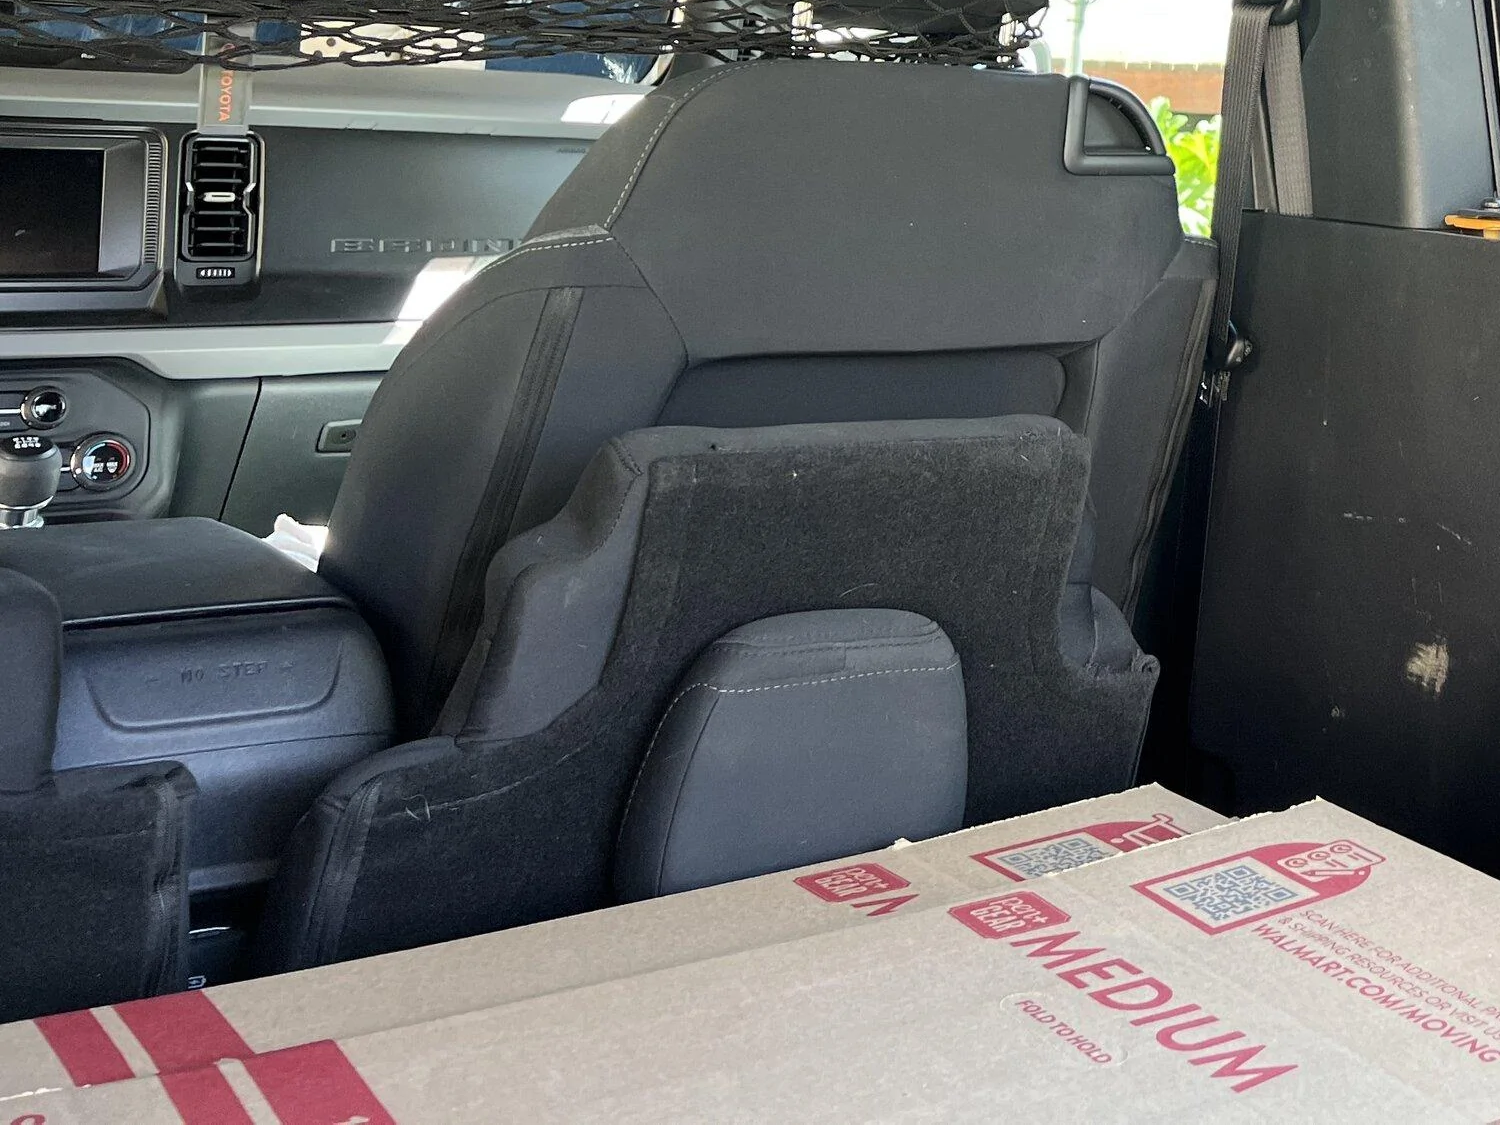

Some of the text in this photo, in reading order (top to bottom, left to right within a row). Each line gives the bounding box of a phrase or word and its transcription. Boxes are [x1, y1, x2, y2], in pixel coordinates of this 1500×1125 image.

[218, 661, 268, 679] STEP
[814, 874, 868, 897] GEAR
[970, 905, 1026, 932] GEAR
[1278, 917, 1293, 925] &
[1288, 922, 1351, 955] SHIPPING
[1345, 953, 1429, 998] RESOURCES
[1424, 996, 1452, 1011] OR
[1448, 1007, 1489, 1028] VISIT
[1300, 910, 1339, 931] SCAN
[1332, 925, 1375, 948] HERE
[1367, 946, 1402, 963] FOR
[1396, 962, 1482, 1009] ADDITIONAL
[1009, 930, 1299, 1094] MEDIUM
[1015, 1000, 1112, 1064] FOLD TO HOLD
